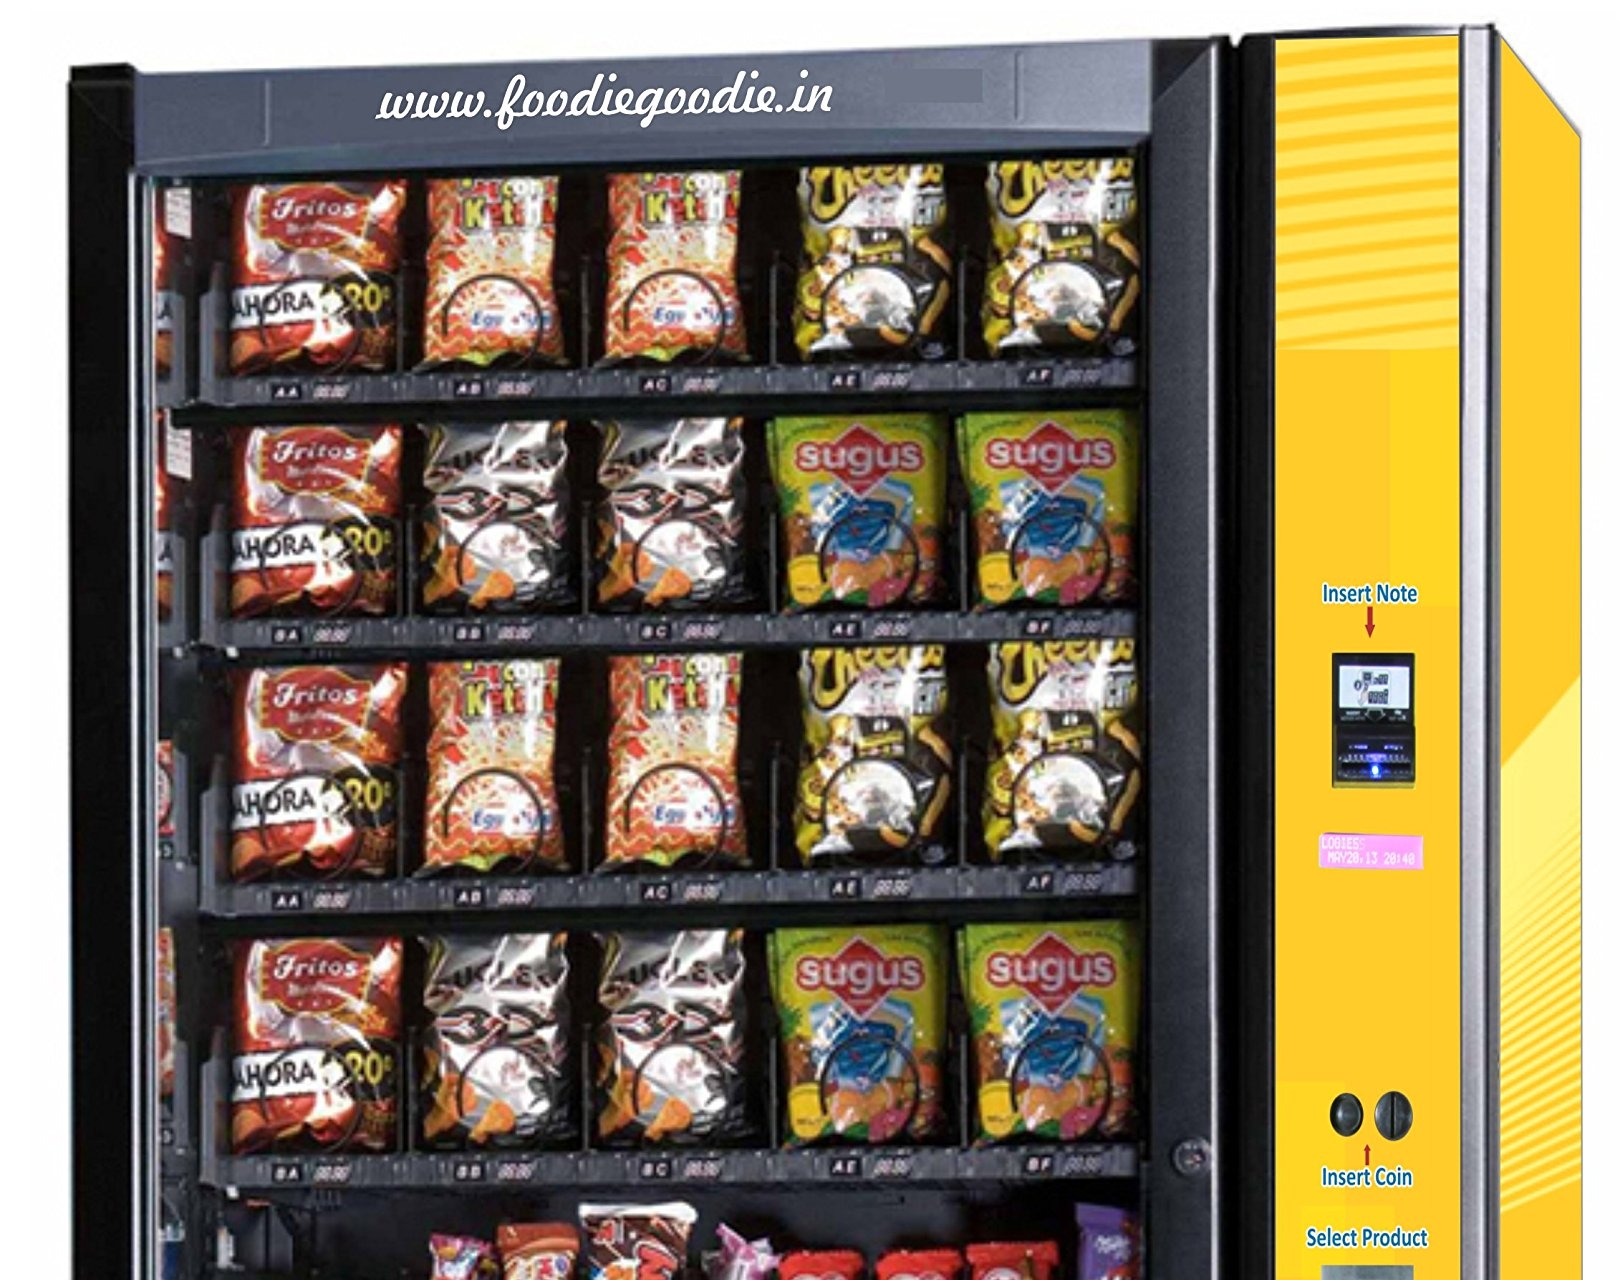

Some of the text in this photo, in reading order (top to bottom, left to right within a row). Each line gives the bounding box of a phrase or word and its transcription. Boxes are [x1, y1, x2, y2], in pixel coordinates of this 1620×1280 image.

[374, 69, 835, 130] www.foodiegoodie.in
[271, 198, 358, 220] Fritos
[272, 442, 359, 464] Fritos
[800, 441, 921, 476] sugus
[990, 439, 1112, 473] sugus
[1323, 584, 1418, 603] Insert Note
[273, 683, 359, 706] Fritos
[273, 955, 359, 980] Fritos
[800, 959, 921, 994] sugus
[991, 957, 1113, 990] sugus
[1322, 1167, 1412, 1186] Insert Coin
[1307, 1228, 1428, 1247] Select Product
